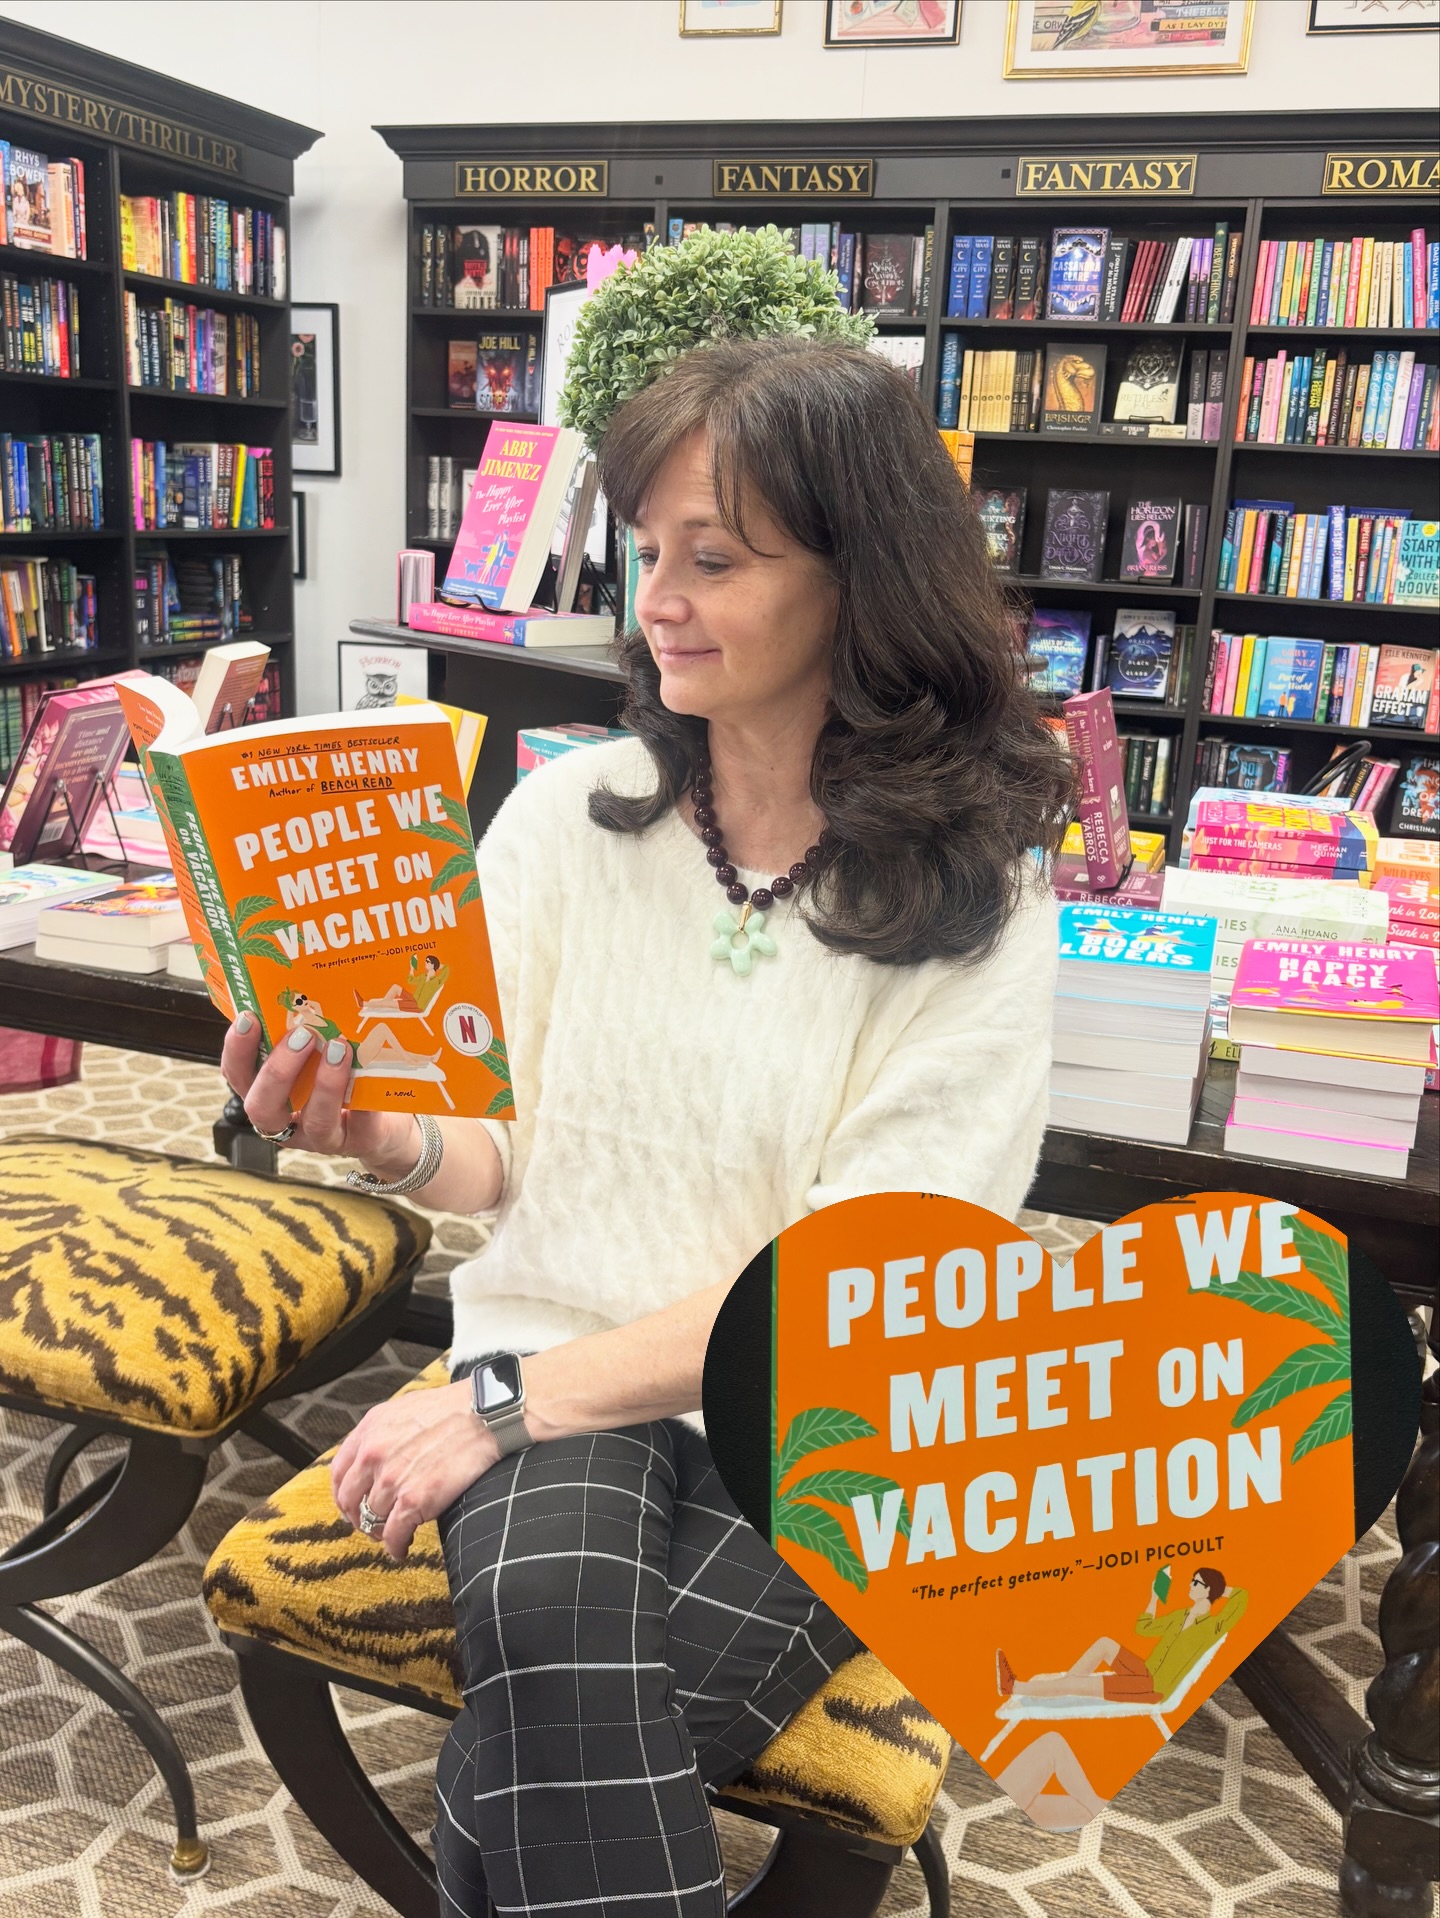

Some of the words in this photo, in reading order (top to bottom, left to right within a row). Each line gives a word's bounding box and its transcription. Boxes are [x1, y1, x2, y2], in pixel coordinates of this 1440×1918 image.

[0, 74, 239, 173] MYSTERY/THRILLER
[15, 150, 40, 167] RHYS
[10, 163, 45, 184] BOWEN
[464, 166, 600, 193] HORROR
[720, 164, 870, 193] FANTASY
[1024, 159, 1192, 191] FANTASY
[1053, 261, 1101, 272] CASSANDRA
[1209, 247, 1223, 301] BEWITCHING
[1062, 271, 1090, 282] CLARE
[1430, 265, 1439, 292] HAITES
[479, 336, 497, 350] JOE
[500, 336, 521, 350] HILL
[1045, 413, 1092, 425] BRISINGR
[1046, 424, 1073, 432] Christopher
[500, 440, 538, 458] ABBY
[481, 458, 542, 481] JIMENEZ
[476, 490, 486, 499] The
[486, 484, 513, 500] Happy
[482, 499, 502, 513] Ever
[503, 497, 524, 514] After
[1131, 506, 1176, 515] HORIZON
[498, 513, 526, 528] Playlist
[1406, 523, 1419, 536] IT
[1401, 554, 1432, 569] WITH
[430, 608, 448, 621] Happy
[448, 612, 462, 622] Ever
[462, 613, 474, 624] After
[474, 616, 496, 627] Playlist
[1385, 649, 1400, 658] ELLE
[1401, 650, 1432, 662] KENNEDY
[1288, 681, 1313, 691] World
[1374, 684, 1427, 705] GRAHAM
[1371, 698, 1411, 715] EFFECT
[1079, 719, 1087, 729] the
[241, 751, 253, 759] #1
[258, 748, 281, 757] NEW
[286, 744, 311, 755] YORK
[314, 741, 342, 751] TIMES
[347, 736, 400, 748] BESTSELLER
[1081, 730, 1094, 766] things
[231, 755, 318, 791] EMILY
[330, 747, 419, 777] HENRY
[1086, 768, 1092, 777] we
[269, 785, 302, 798] Author
[306, 783, 316, 793] of
[320, 779, 359, 792] BEACH
[363, 776, 393, 788] READ
[1087, 778, 1095, 793] leave
[1244, 778, 1255, 789] OF
[1420, 792, 1435, 802] OF
[233, 798, 381, 871] PEOPLE
[387, 784, 448, 829] WE
[1399, 822, 1436, 834] CHRISTINA
[184, 811, 212, 875] PEOPLE
[1082, 816, 1097, 862] YARROS
[1093, 811, 1109, 865] REBECCA
[1201, 837, 1215, 846] JUST
[1216, 838, 1233, 847] FOR
[1234, 839, 1247, 848] THE
[1247, 840, 1282, 851] CAMERAS
[1310, 843, 1348, 854] MEGHAN
[1313, 850, 1343, 859] QUINN
[179, 827, 189, 845] ON
[186, 848, 223, 929] VACATION
[276, 854, 380, 910] MEET
[395, 851, 433, 884] ON
[1383, 867, 1407, 879] WILD
[1409, 871, 1432, 881] EYES
[209, 876, 222, 902] WE
[1080, 893, 1133, 906] REBECCA
[1072, 908, 1135, 920] EMILY
[1141, 914, 1209, 927] HENRY
[1406, 908, 1415, 917] in
[217, 903, 238, 950] MEET
[273, 892, 458, 961] VACATION
[1276, 925, 1300, 935] ANA
[1302, 928, 1338, 940] HUANG
[1387, 923, 1419, 938] Sunk
[1419, 930, 1429, 940] in
[1059, 942, 1194, 966] LOVERS
[1081, 935, 1178, 955] BOOK
[1252, 941, 1326, 956] EMILY
[1338, 946, 1418, 960] HENRY
[328, 958, 350, 969] perfect
[405, 941, 437, 953] PICOULT
[1278, 957, 1389, 977] HAPPY
[226, 955, 254, 1011] EMILY
[1278, 969, 1388, 989] PLACE
[459, 1015, 477, 1043] N
[394, 1090, 416, 1098] novel
